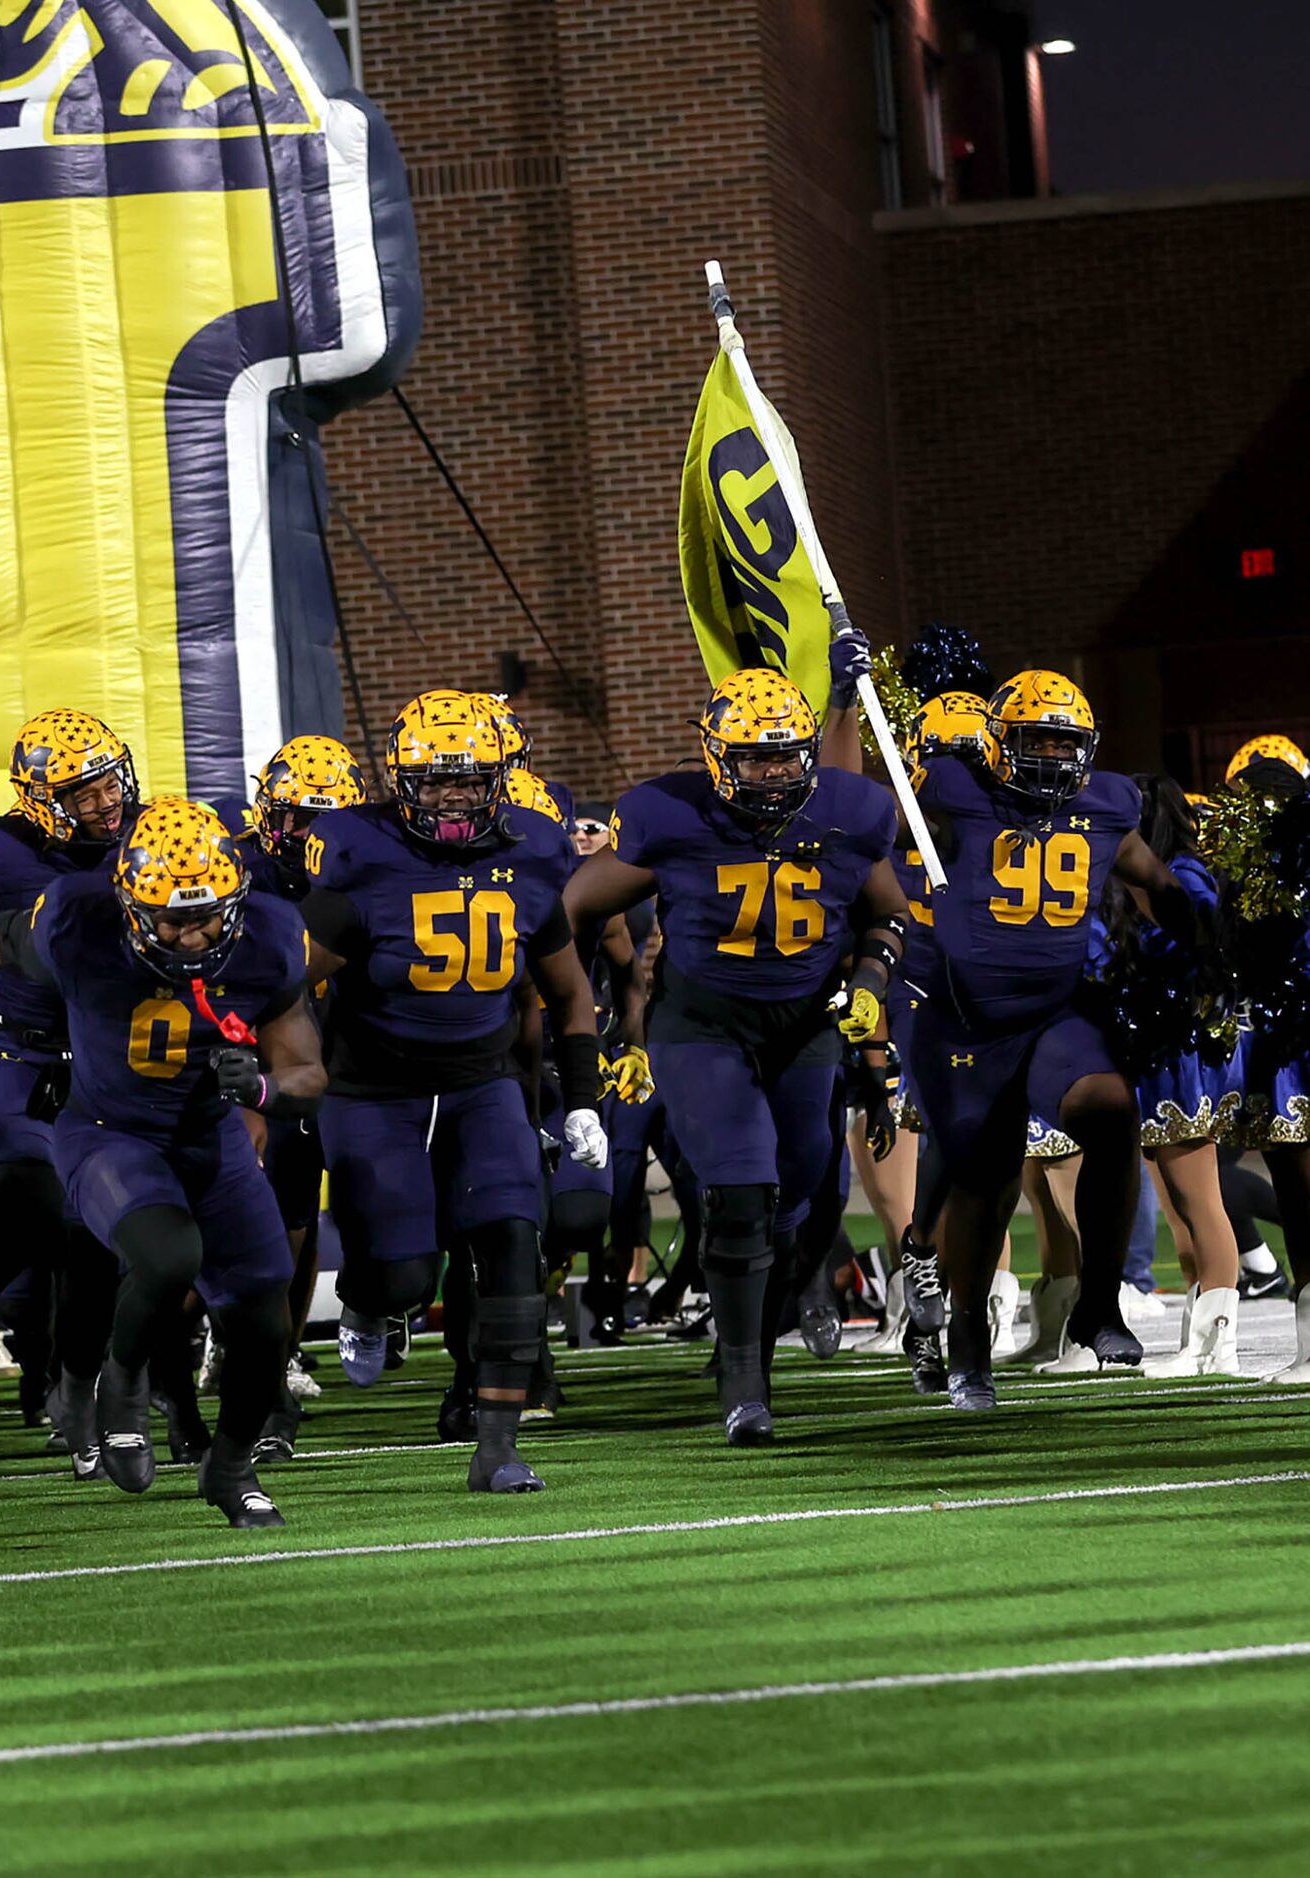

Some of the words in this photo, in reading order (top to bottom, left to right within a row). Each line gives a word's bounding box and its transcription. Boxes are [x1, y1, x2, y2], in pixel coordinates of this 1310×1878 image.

[178, 887, 207, 901] WAWG
[716, 861, 826, 958] 76
[988, 829, 1091, 928] 99
[408, 889, 518, 992] 50
[128, 999, 192, 1079] 0
